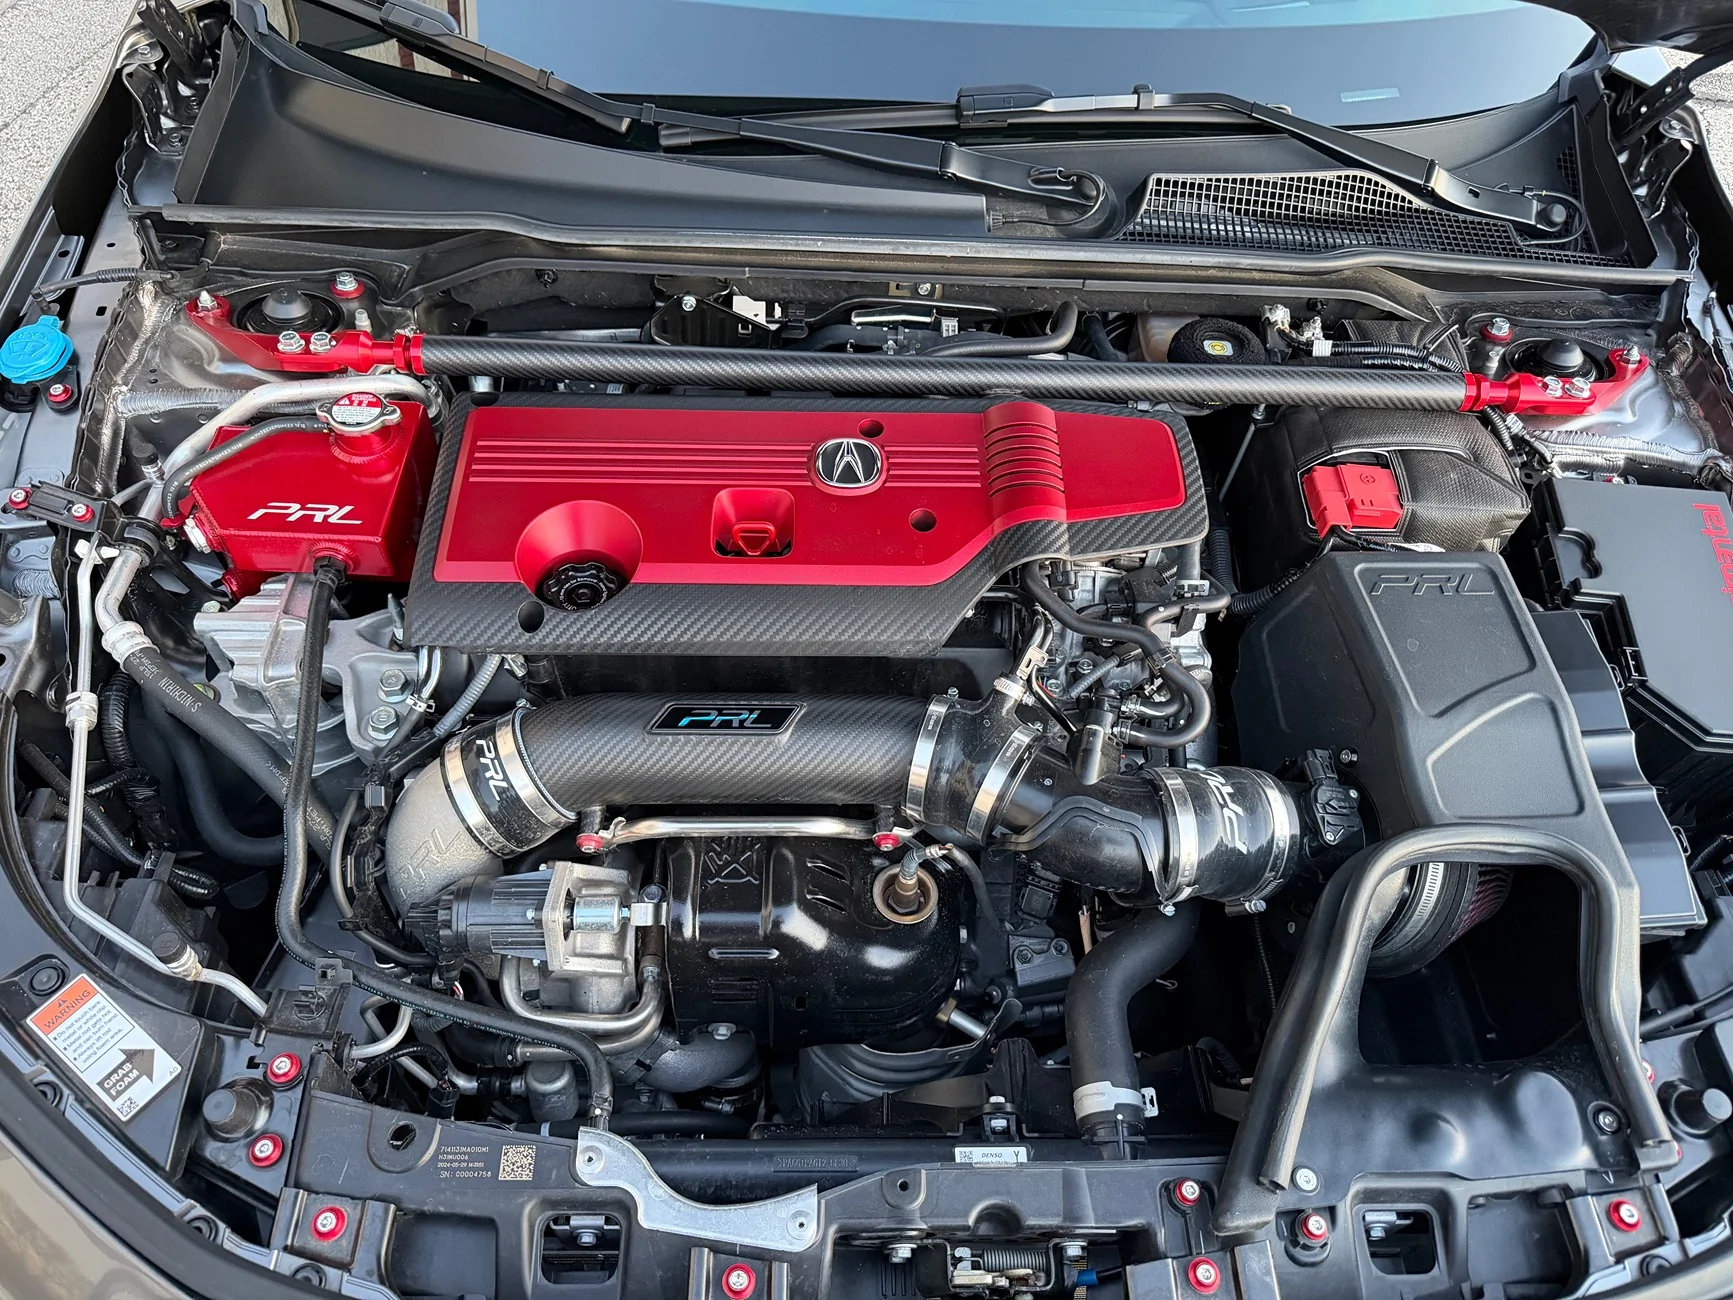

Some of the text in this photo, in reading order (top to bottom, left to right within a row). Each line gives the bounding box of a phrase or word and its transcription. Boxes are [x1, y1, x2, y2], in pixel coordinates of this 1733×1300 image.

[247, 502, 362, 524] PRL
[1371, 573, 1495, 595] PRL
[678, 710, 772, 727] PRL
[476, 739, 508, 801] PRL
[44, 988, 90, 1029] WARNING
[102, 1061, 133, 1089] GRAB
[109, 1068, 139, 1096] FOAM
[440, 1170, 454, 1178] SN:
